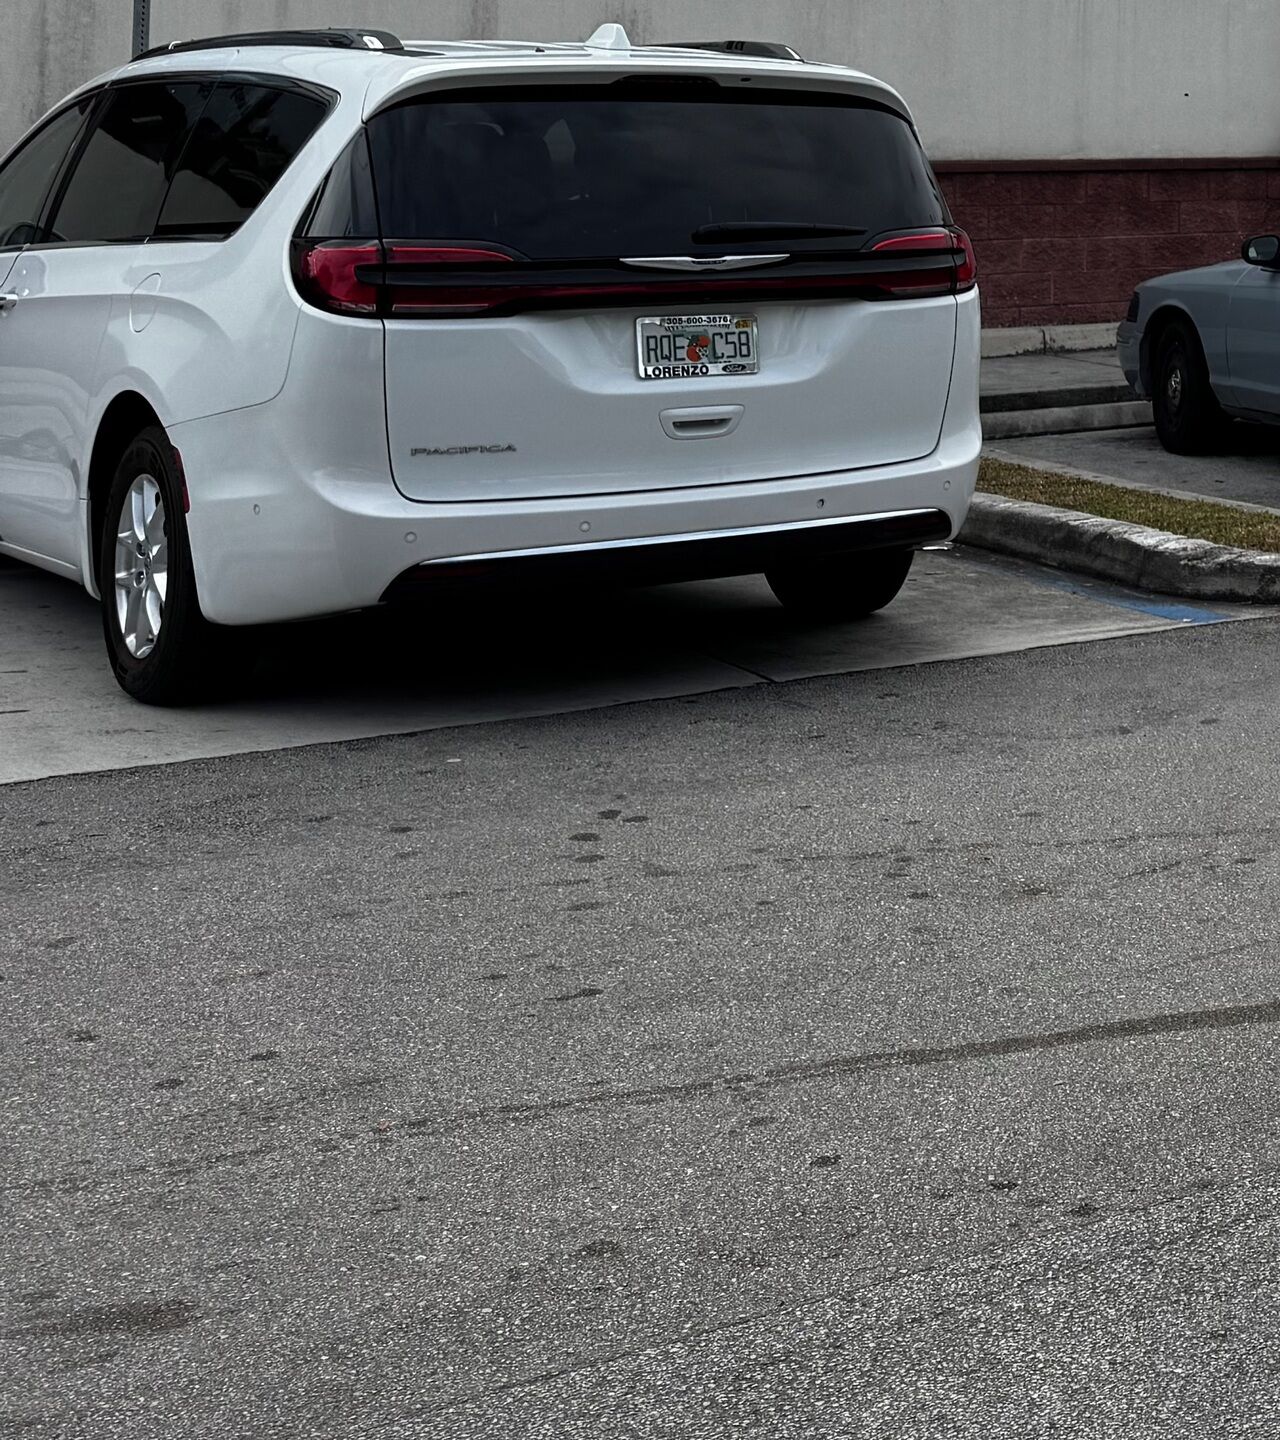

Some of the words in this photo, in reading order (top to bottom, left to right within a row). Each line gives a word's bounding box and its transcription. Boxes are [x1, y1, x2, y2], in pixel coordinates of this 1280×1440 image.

[646, 334, 686, 363] RQE
[644, 365, 710, 378] LORENZO
[410, 443, 517, 456] PACIFICA
